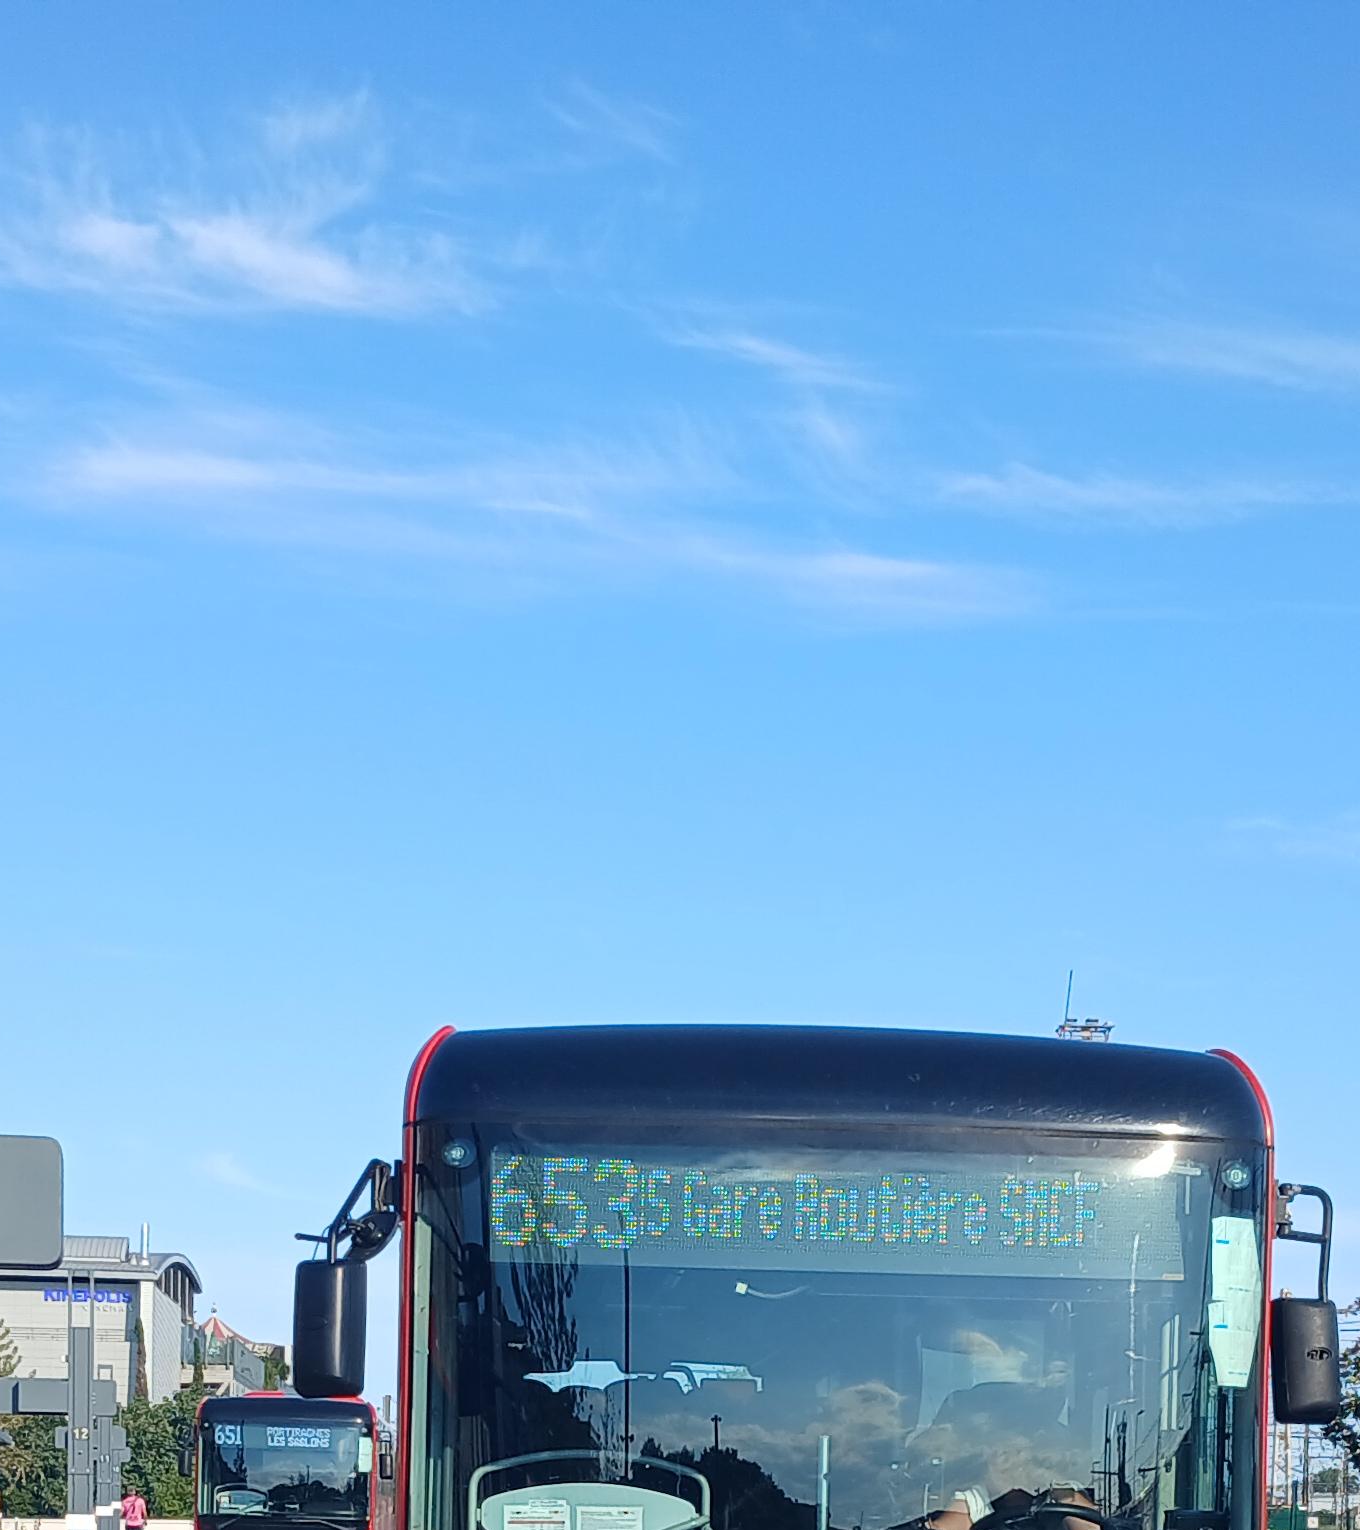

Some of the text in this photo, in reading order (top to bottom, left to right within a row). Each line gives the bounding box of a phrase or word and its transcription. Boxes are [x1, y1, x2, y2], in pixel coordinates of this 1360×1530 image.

[492, 1155, 638, 1249] 653
[683, 1169, 782, 1240] Gare
[795, 1173, 986, 1245] Routière
[1001, 1177, 1100, 1247] SNCF
[73, 1427, 89, 1440] 12
[214, 1425, 242, 1445] 651
[268, 1437, 285, 1446] LES
